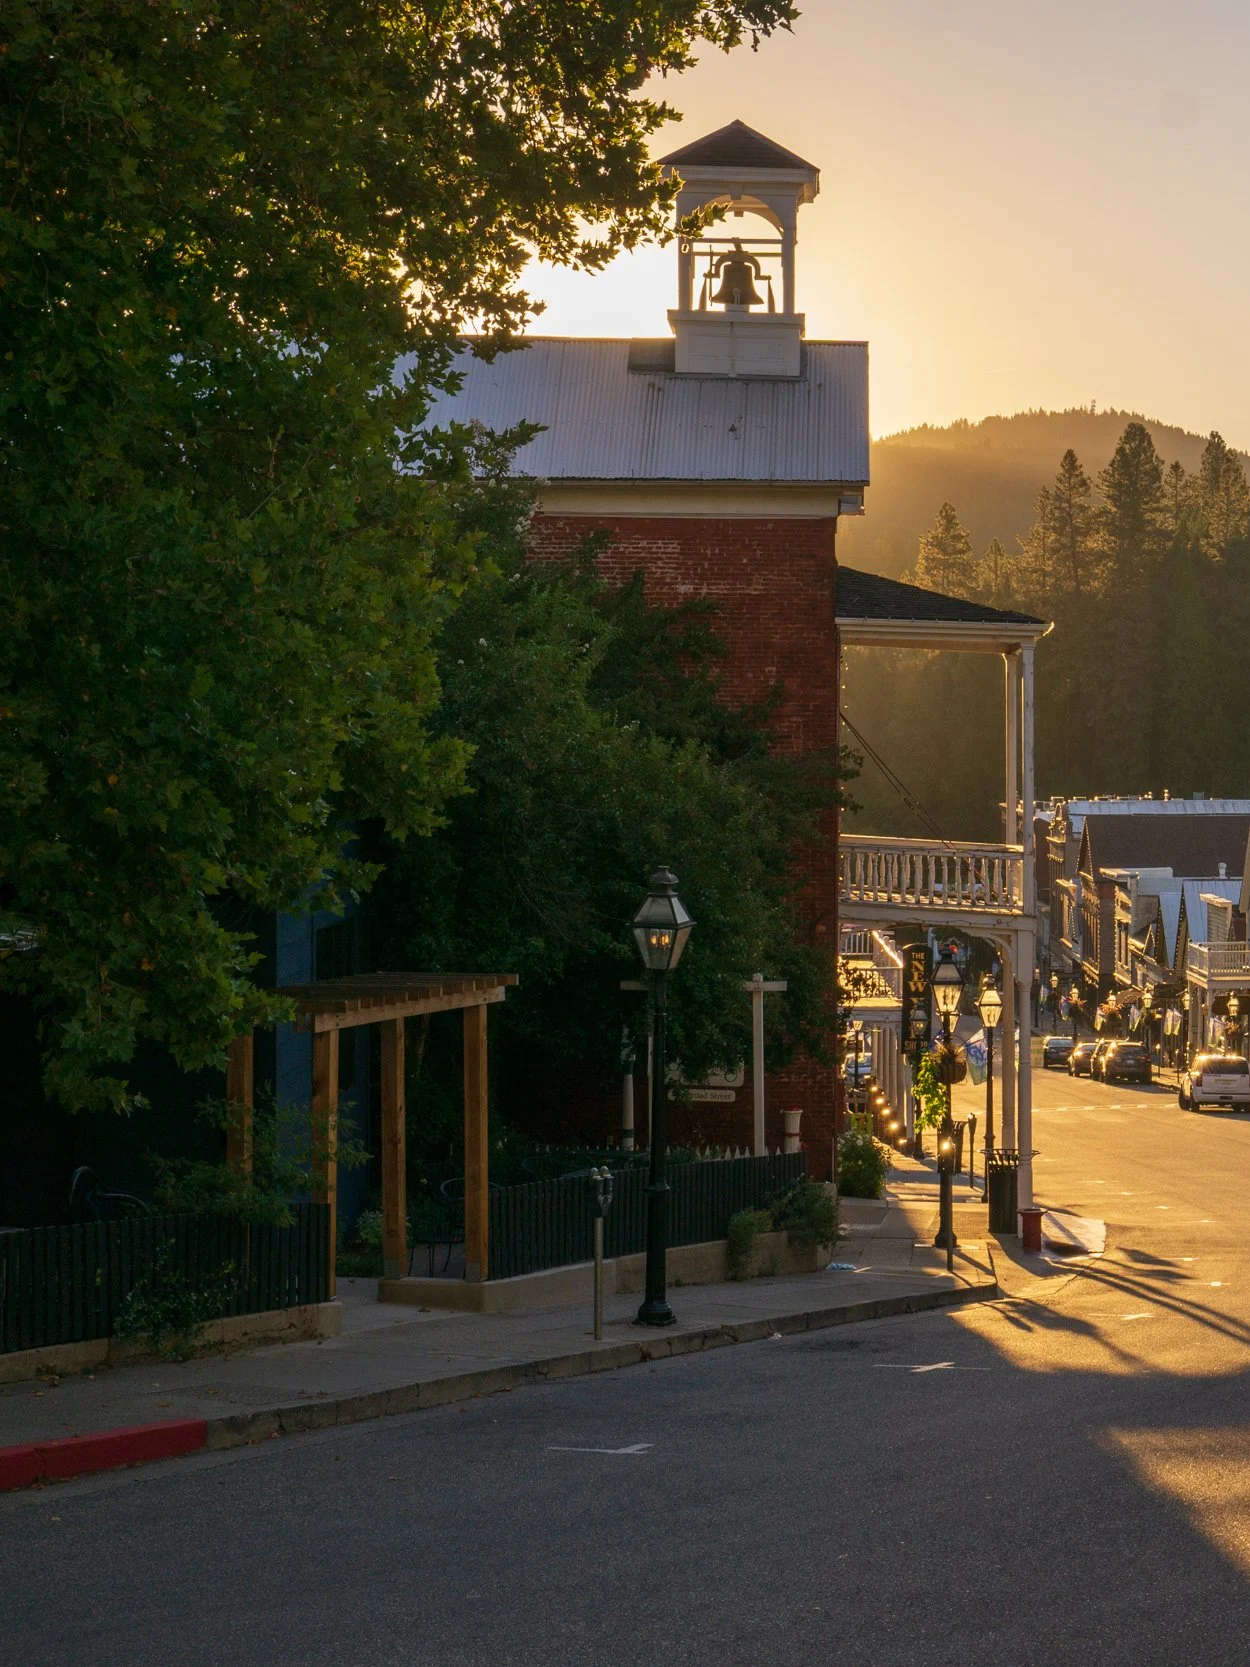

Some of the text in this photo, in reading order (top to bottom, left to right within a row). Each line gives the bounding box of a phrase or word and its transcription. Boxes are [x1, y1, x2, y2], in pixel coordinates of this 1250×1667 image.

[908, 960, 926, 992] NEW
[904, 1040, 928, 1050] SHS
[710, 1091, 731, 1100] Street
